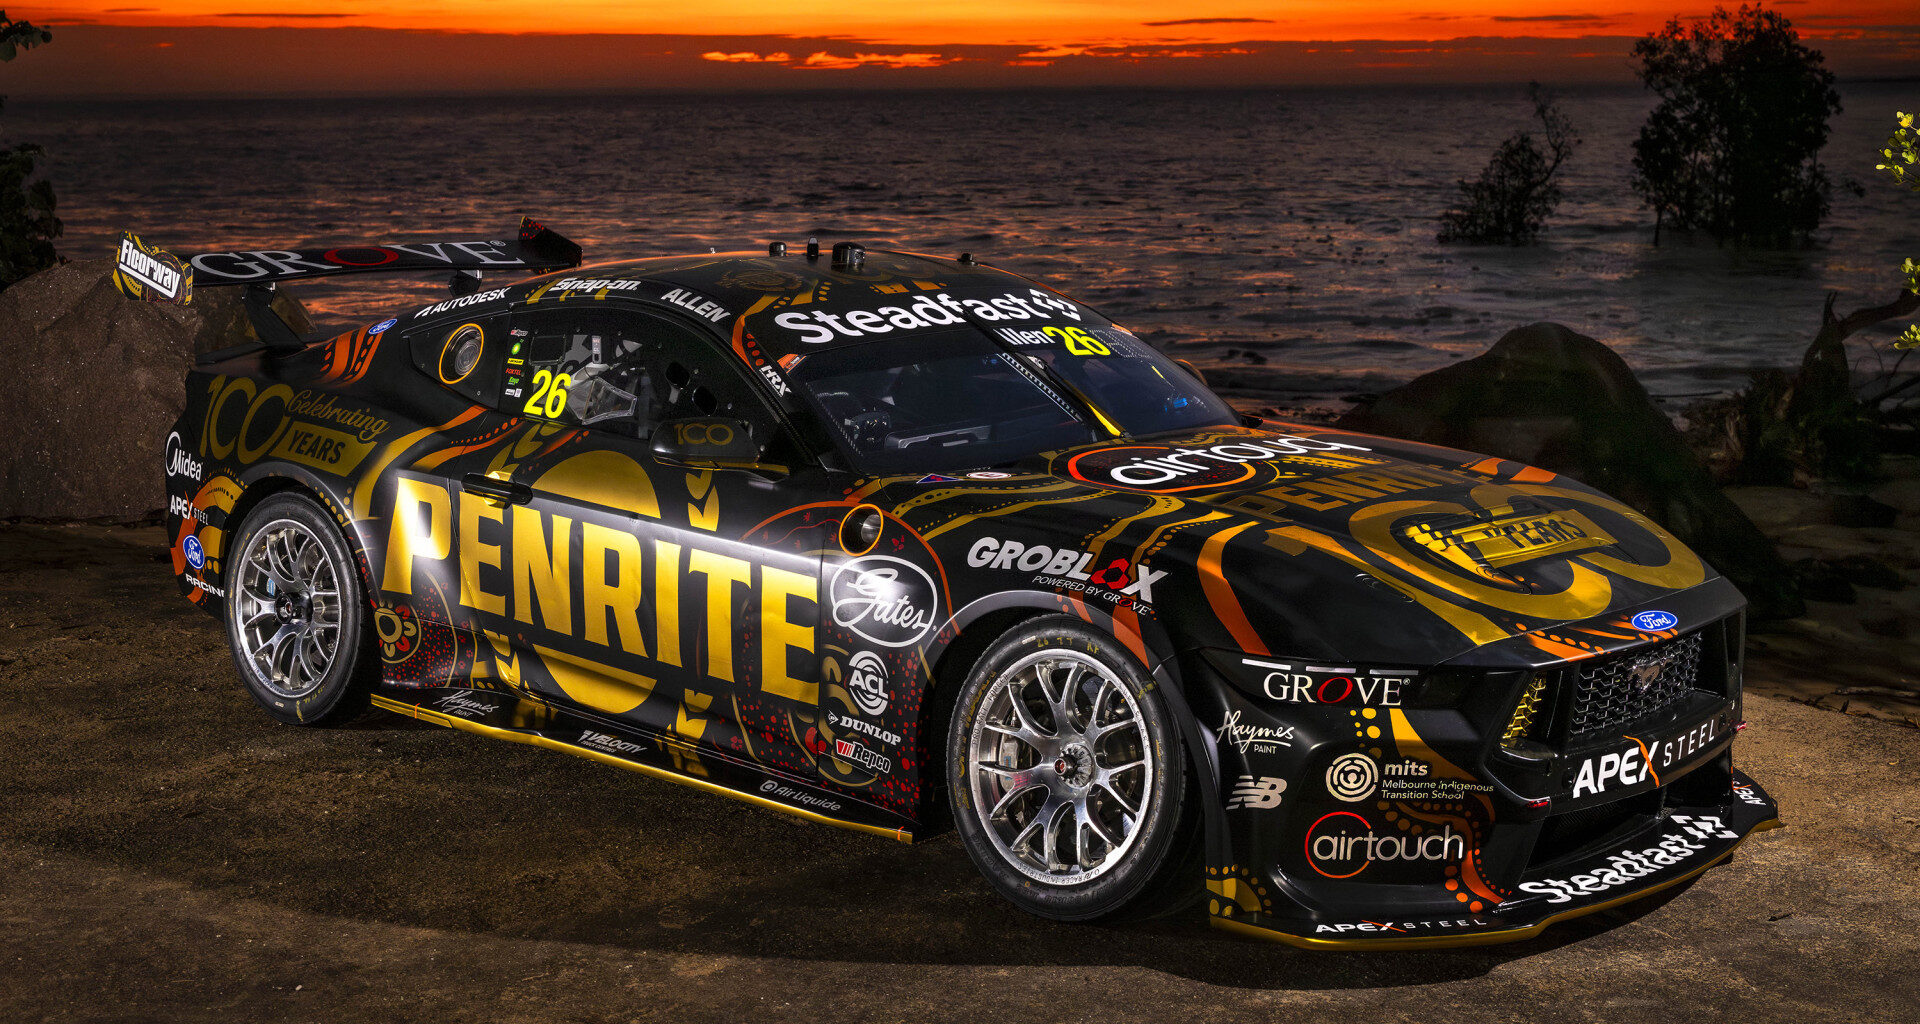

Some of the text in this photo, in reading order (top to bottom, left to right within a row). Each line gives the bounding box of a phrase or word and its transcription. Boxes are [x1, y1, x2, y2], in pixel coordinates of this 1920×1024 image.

[120, 239, 181, 292] Floorway
[429, 287, 512, 314] AUTODESK
[661, 288, 732, 323] ALLEN
[774, 293, 1052, 344] Steadfast
[1042, 326, 1111, 356] 26
[523, 369, 572, 419] 26
[760, 365, 793, 397] HRX
[288, 389, 391, 441] Celebrating
[166, 432, 202, 481] Midea
[288, 430, 346, 464] YEARS
[170, 492, 209, 526] APEX STEEL
[381, 477, 819, 707] PENRITE
[834, 568, 929, 629] Gates
[1032, 576, 1150, 615] POWERED BY GROVE
[849, 669, 889, 700] ACL
[587, 732, 648, 754] VELOCITY
[840, 716, 901, 746] DUNLOP
[1216, 710, 1294, 754] Haymes
[851, 742, 891, 774] Repco
[1254, 744, 1277, 755] PAINT
[1573, 719, 1715, 798] APEX STEEL
[1382, 779, 1437, 789] Melbourne
[1384, 760, 1428, 776] mits
[774, 786, 841, 811] Air Liquide
[1381, 789, 1465, 800] Transition School
[1313, 825, 1464, 861] airtouch
[1519, 832, 1705, 903] Steadfast
[1315, 918, 1487, 933] APEX STEEL
